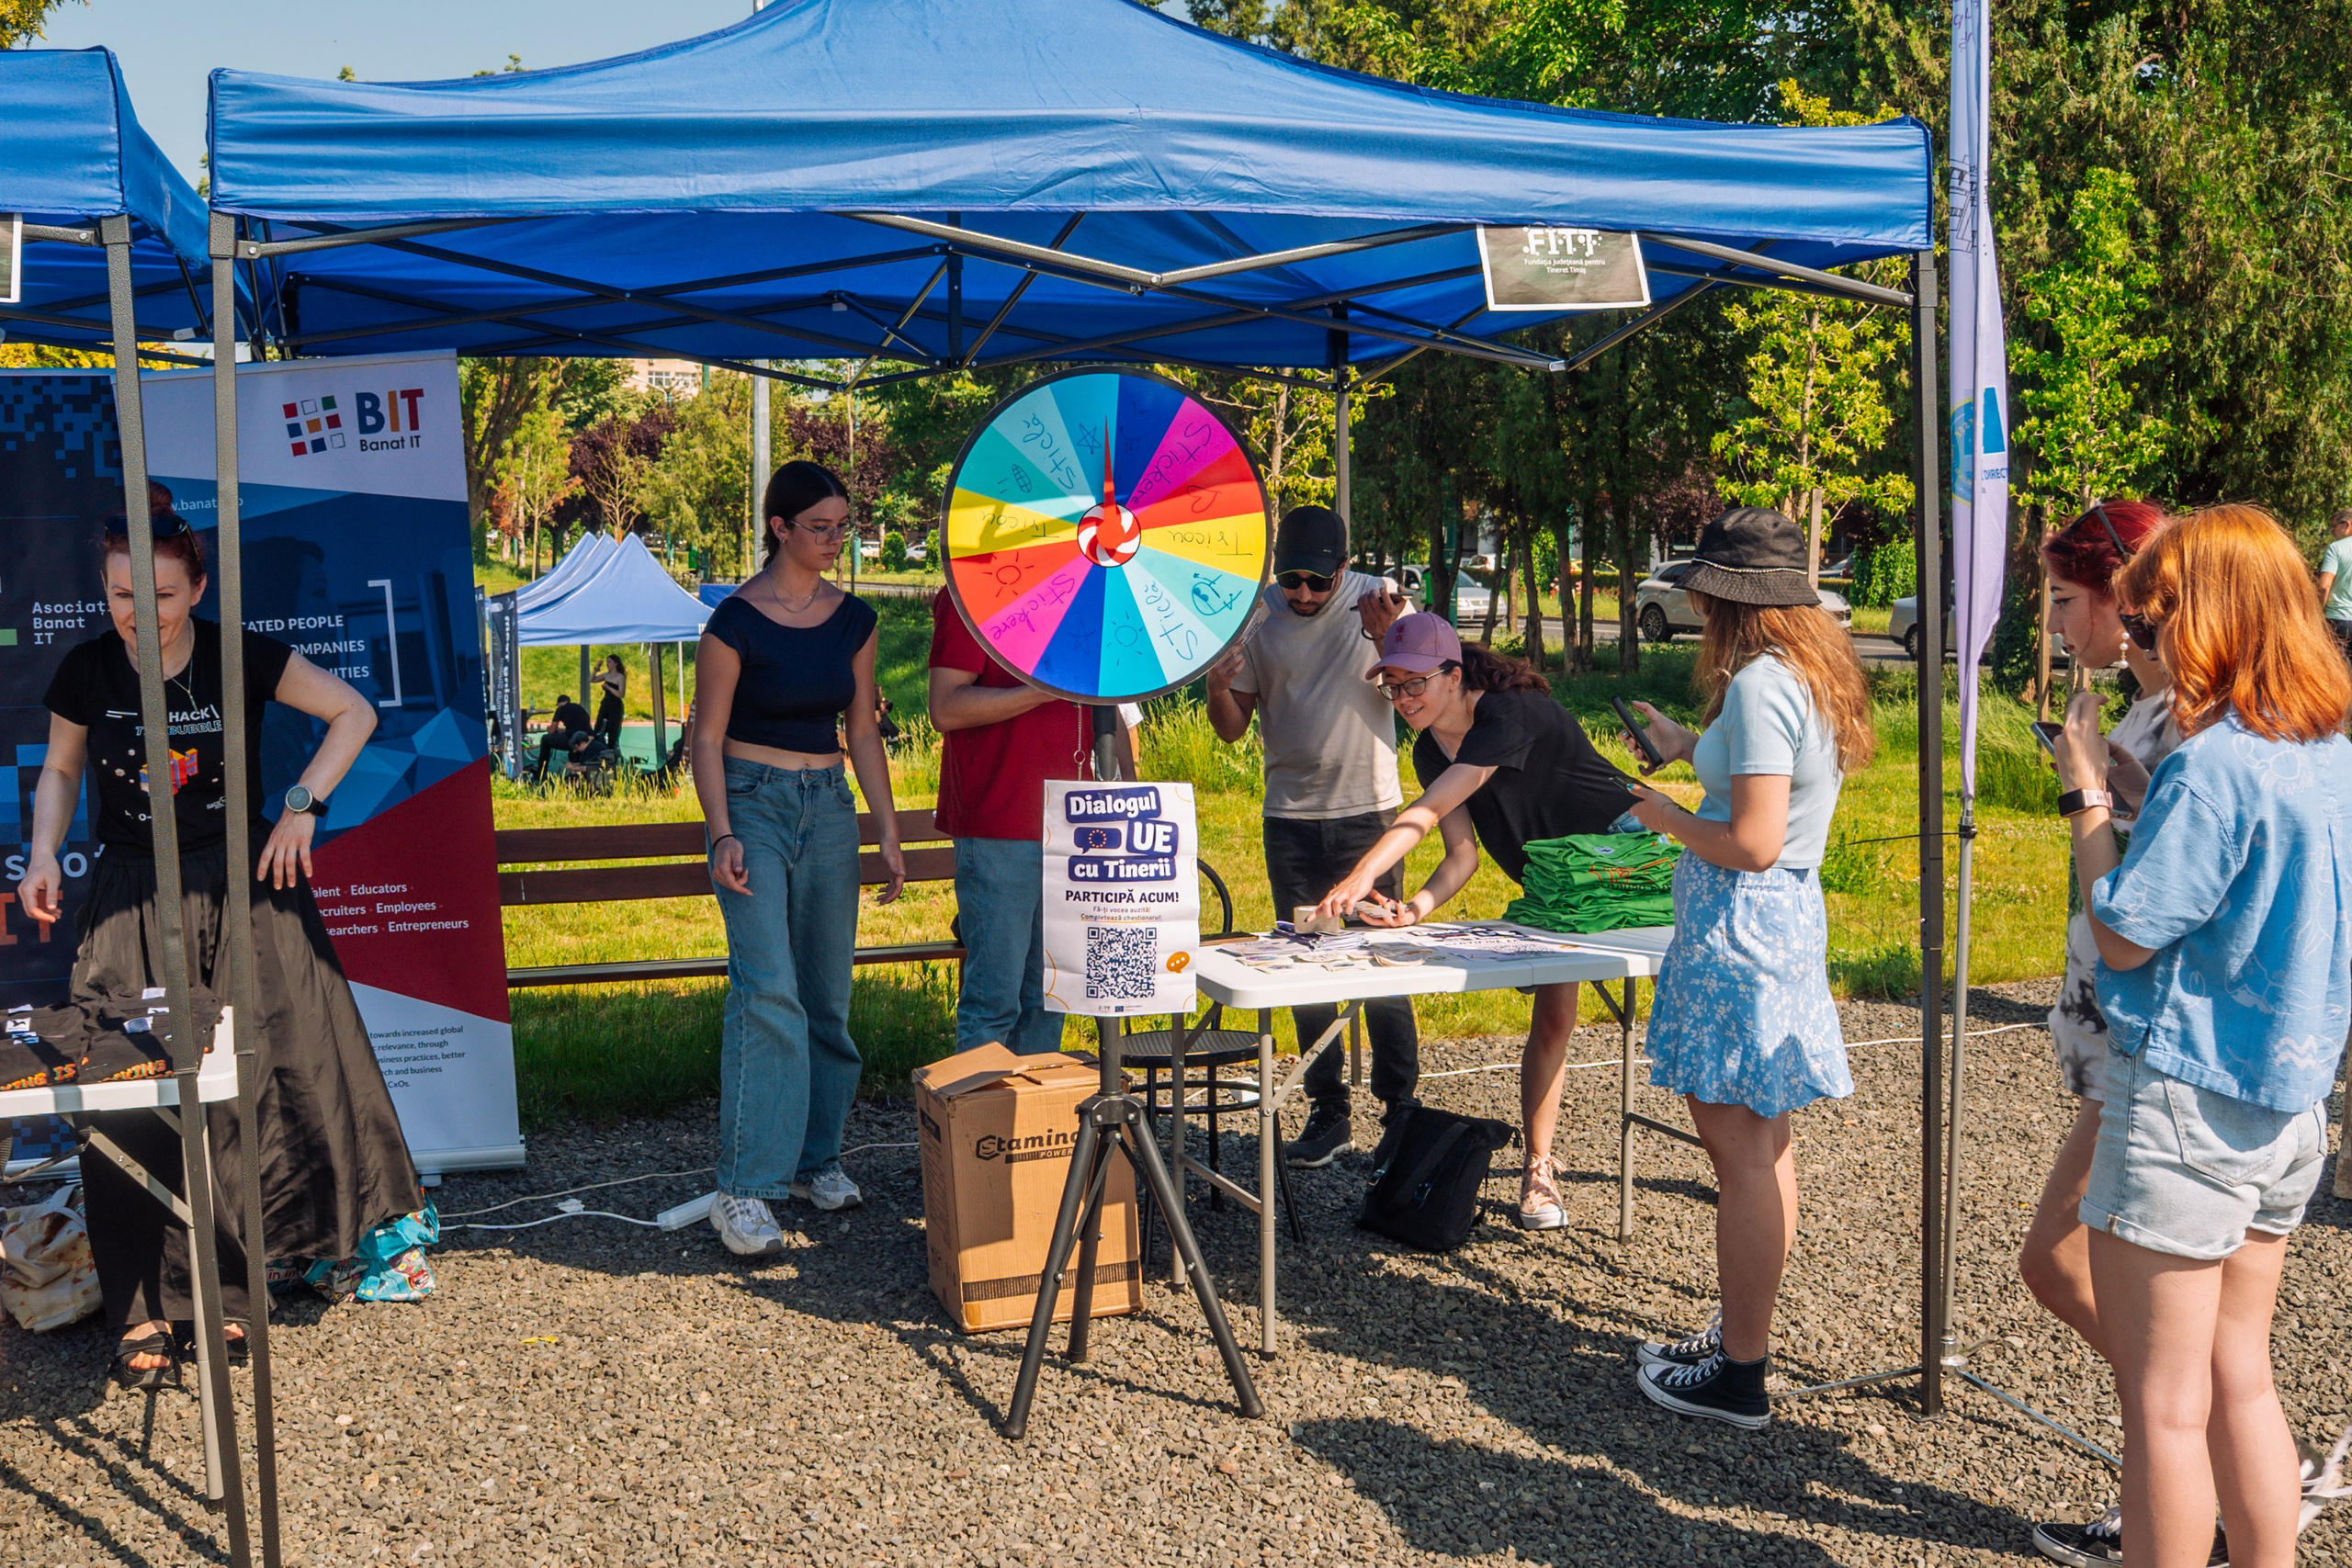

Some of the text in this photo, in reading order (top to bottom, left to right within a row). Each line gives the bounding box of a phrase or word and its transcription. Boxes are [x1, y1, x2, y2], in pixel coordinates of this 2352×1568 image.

[1524, 228, 1600, 256] FITT
[356, 389, 424, 434] BIT
[360, 435, 422, 451] Banat IT
[979, 510, 1059, 539] Tricou
[1170, 530, 1253, 557] Tricou
[32, 601, 111, 615] Asociaț
[989, 573, 1075, 641] Stickere
[33, 617, 85, 629] Banat
[288, 615, 344, 630] PEOPLE
[34, 632, 55, 644] IT
[1069, 791, 1157, 818] Dialogul
[1133, 821, 1173, 853] UE
[1074, 860, 1171, 879] cu Tinerii
[350, 884, 407, 896] Educators
[1065, 888, 1179, 903] PARTICIPĂ ACUM!
[376, 902, 436, 914] Employees
[388, 919, 469, 933] Entrepreneurs
[370, 1026, 464, 1039] towards increased global
[378, 1043, 417, 1051] relevance,
[418, 1039, 449, 1049] through
[404, 1053, 441, 1063] practices,
[441, 1051, 466, 1060] better
[410, 1066, 442, 1075] business
[1040, 1148, 1073, 1158] POWER
